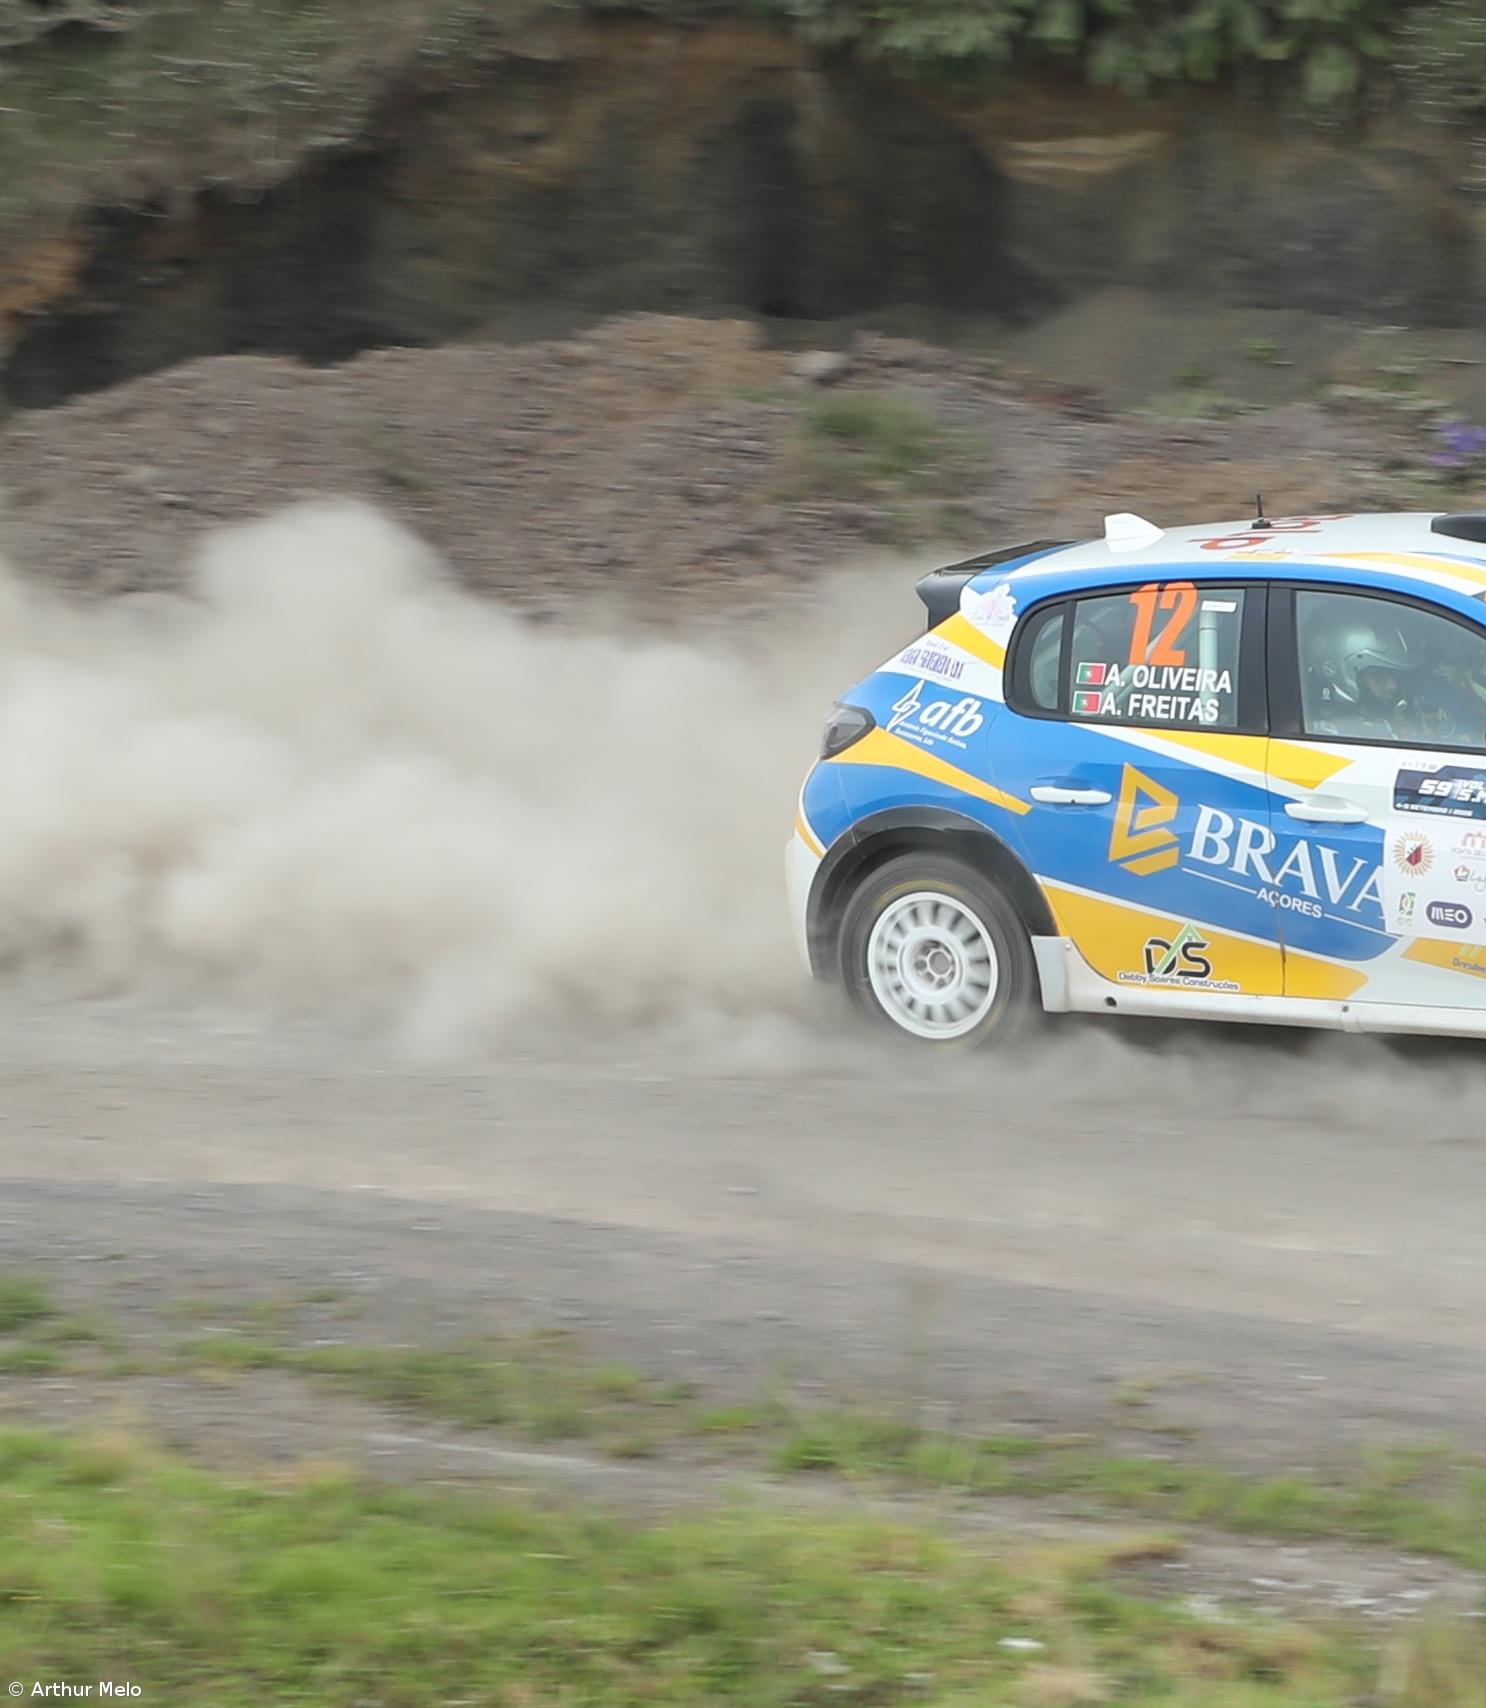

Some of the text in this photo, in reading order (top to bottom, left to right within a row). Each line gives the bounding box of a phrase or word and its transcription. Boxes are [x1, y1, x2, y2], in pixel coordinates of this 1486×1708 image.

[1129, 581, 1198, 666] 12
[1104, 663, 1232, 693] A. OLIVEIRA
[919, 697, 984, 737] afb
[1100, 692, 1219, 722] A. FREITAS
[1185, 803, 1386, 920] BRAVA
[1256, 887, 1323, 919] AÇORES
[1431, 906, 1468, 923] MEO
[1118, 972, 1239, 990] Debby Soares Construções
